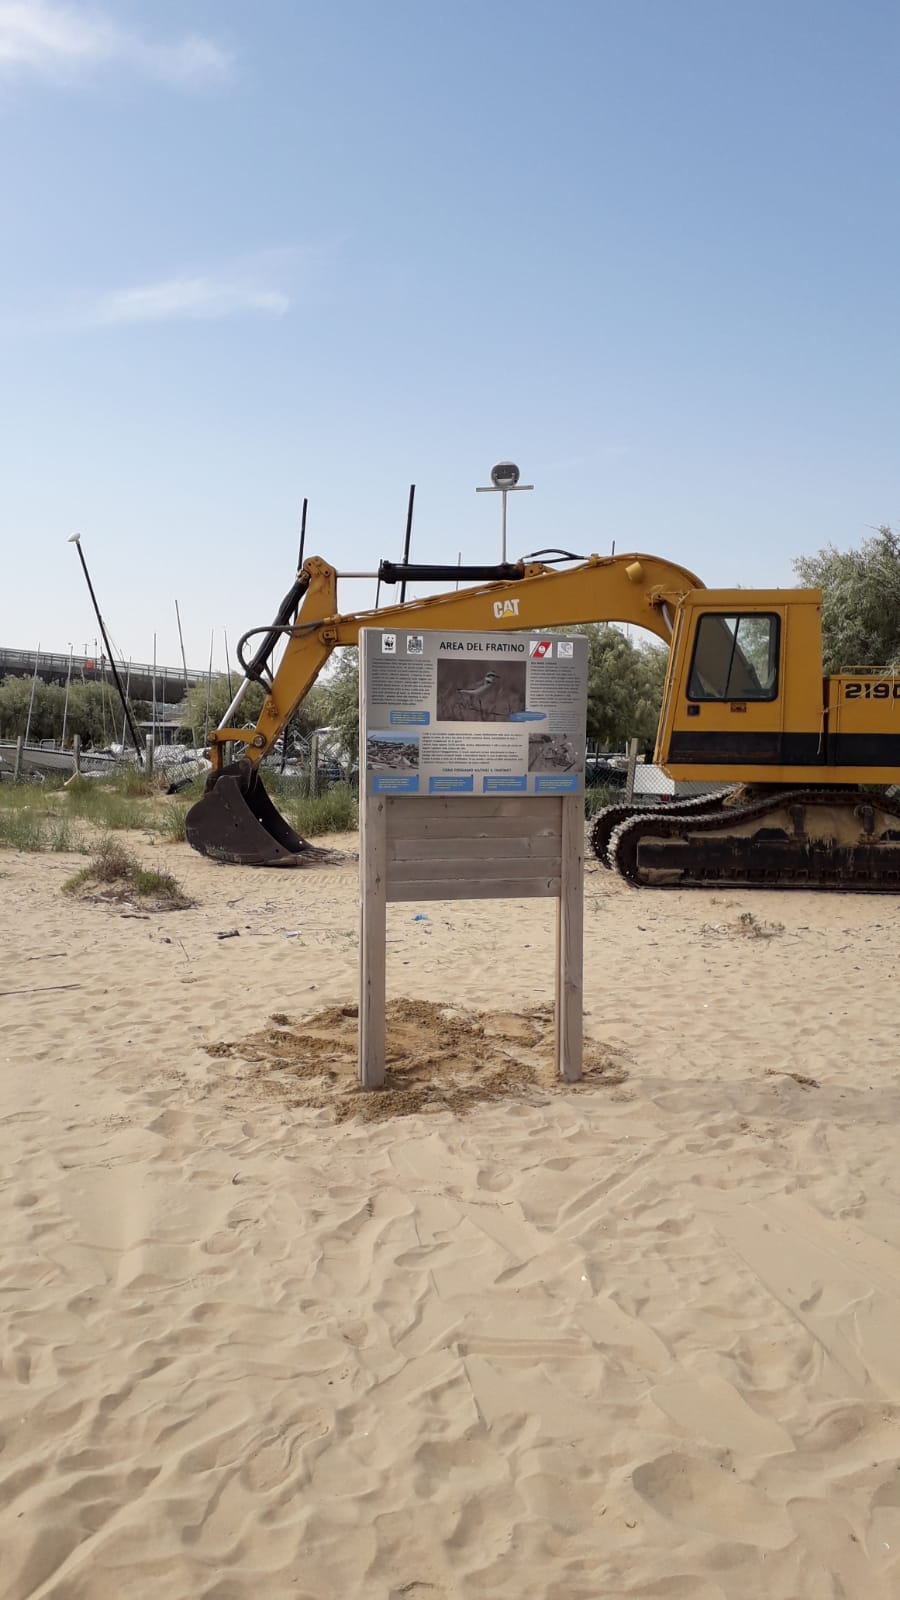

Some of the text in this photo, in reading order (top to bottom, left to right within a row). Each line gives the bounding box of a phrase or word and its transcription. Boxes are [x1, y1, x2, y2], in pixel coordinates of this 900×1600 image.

[493, 598, 520, 618] CAT
[440, 641, 525, 652] AREA DEL FRATINO
